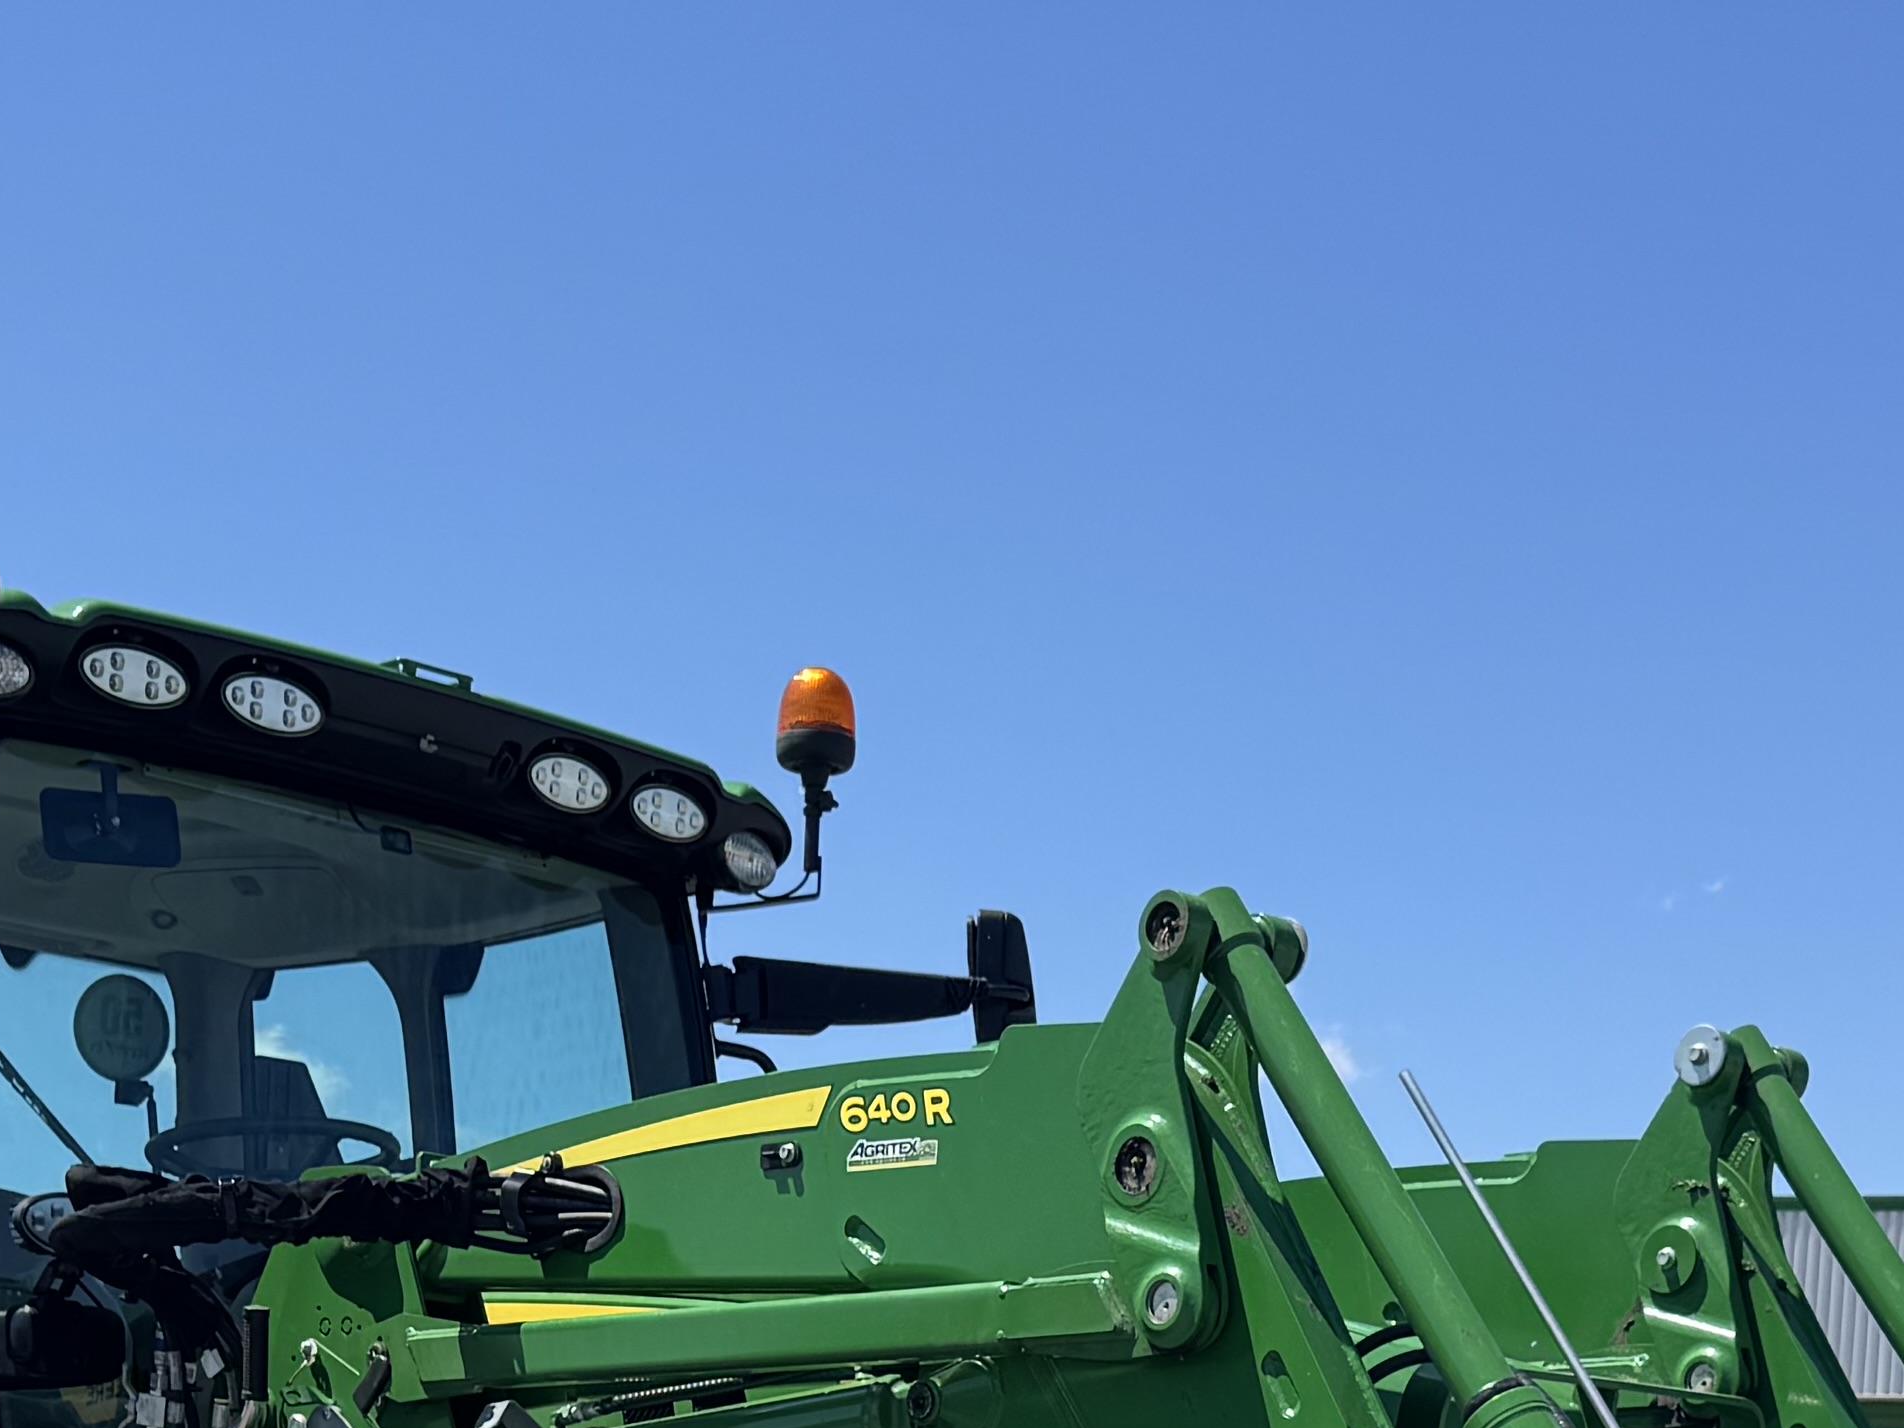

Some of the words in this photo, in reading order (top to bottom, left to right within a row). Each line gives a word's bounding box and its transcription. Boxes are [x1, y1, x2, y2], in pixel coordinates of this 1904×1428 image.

[840, 1091, 916, 1133] 640
[924, 1088, 954, 1126] R
[850, 1139, 919, 1158] AGRITEX
